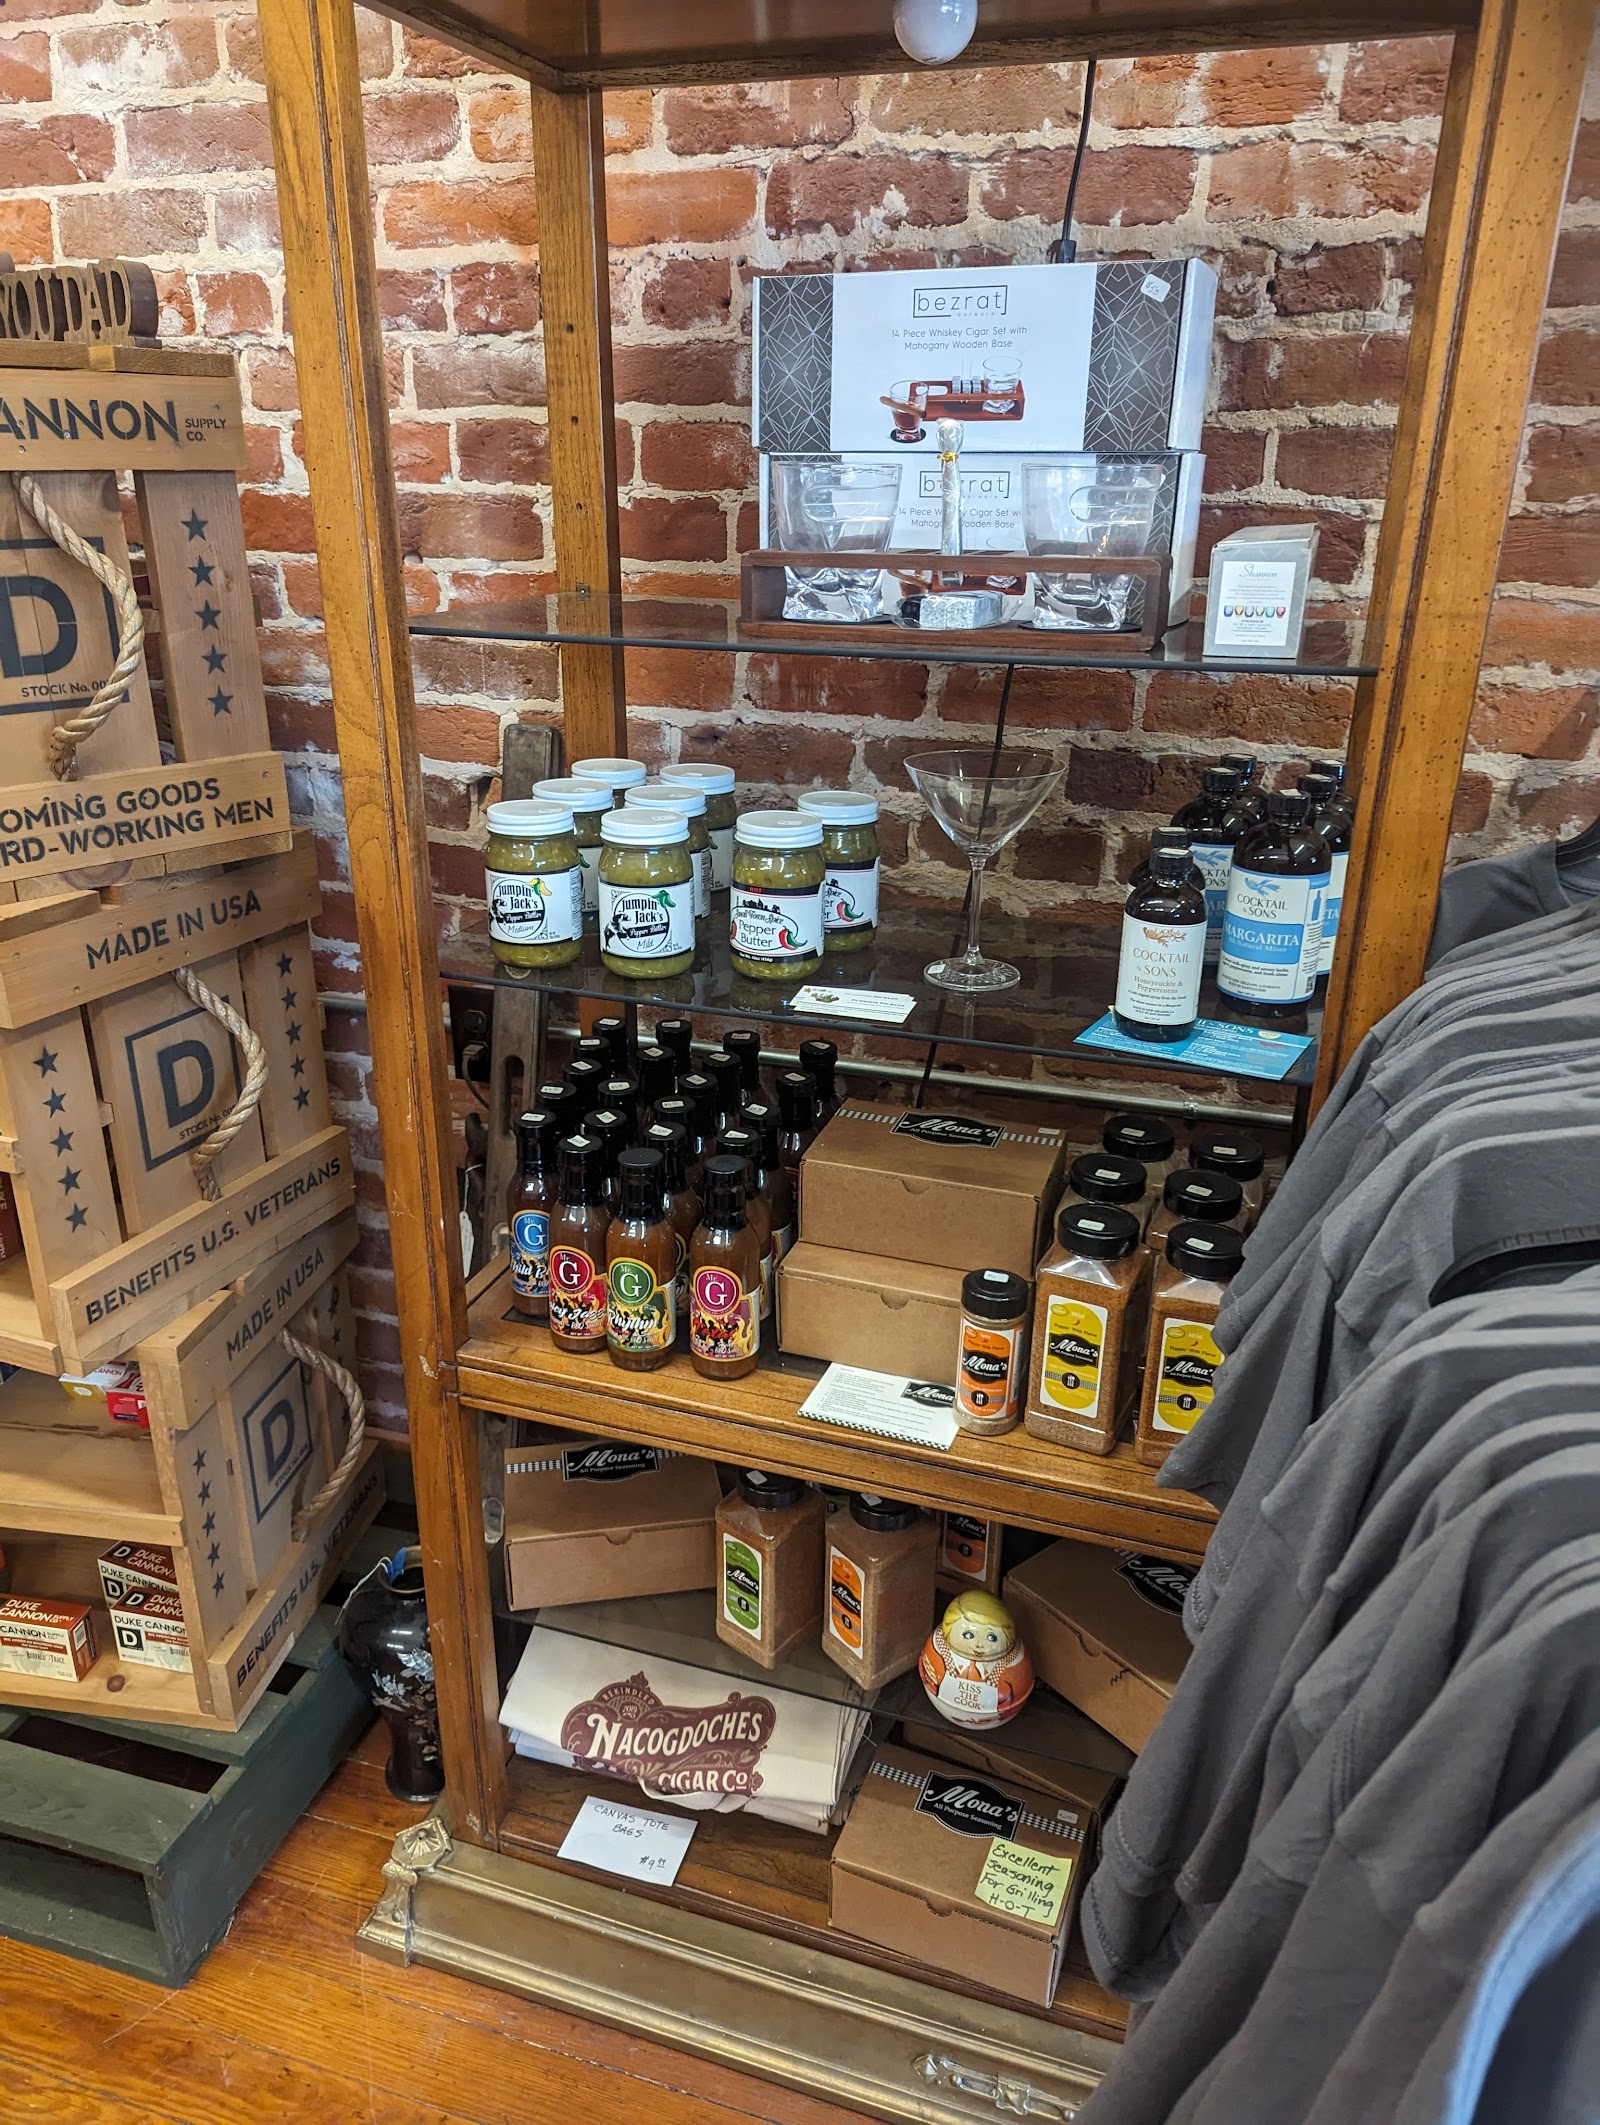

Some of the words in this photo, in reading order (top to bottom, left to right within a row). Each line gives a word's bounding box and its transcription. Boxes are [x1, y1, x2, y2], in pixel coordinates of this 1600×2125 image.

[55, 259, 132, 341] DAD
[917, 291, 1002, 312] bezrat
[891, 329, 900, 338] 14
[903, 329, 926, 338] Piece
[929, 328, 962, 341] Whiskey
[965, 327, 989, 338] Cigar
[992, 326, 1006, 336] Set
[1009, 326, 1027, 335] with
[904, 341, 949, 352] Mahogany
[952, 340, 988, 349] Wooden
[991, 339, 1013, 348] Base
[0, 397, 179, 441] ANNON
[184, 417, 226, 431] SUPPLY
[186, 430, 206, 442] CO.
[910, 508, 932, 516] Piece
[970, 508, 993, 517] Cigar
[996, 508, 1009, 516] Set
[995, 520, 1015, 528] Base
[2, 575, 78, 678] D
[21, 683, 67, 698] STOCK
[70, 682, 89, 694] No.
[0, 794, 107, 833] OMING
[116, 777, 221, 815] GOODS
[0, 808, 205, 868] RD-WORKING
[214, 796, 274, 829] MEN
[1205, 877, 1226, 887] ONS
[496, 885, 534, 898] Jumpin'
[510, 896, 538, 911] Jack's
[618, 897, 660, 913] Jumpin'
[1237, 893, 1288, 911] COCKTAIL
[634, 910, 664, 925] Jack's
[1248, 907, 1277, 920] SONS
[85, 917, 169, 971] MADE
[176, 906, 205, 940] IN
[210, 889, 262, 928] USA
[507, 924, 534, 934] Medium
[739, 919, 777, 936] Pepper
[1225, 921, 1300, 946] MARGARITA
[637, 938, 655, 951] Mild
[740, 933, 773, 948] Butter
[1133, 947, 1191, 963] COCKTAIL
[1143, 964, 1177, 978] SONS
[1134, 975, 1176, 987] Honeysuckle
[1137, 983, 1178, 994] Peppercorns
[1219, 1020, 1254, 1036] SONS
[156, 1039, 214, 1129] D
[179, 1119, 210, 1140] STOCK
[899, 1118, 998, 1138] Mona's
[921, 1129, 948, 1137] Purpose
[948, 1133, 982, 1142] Seasoning
[523, 1217, 536, 1225] Mr.
[85, 1244, 197, 1326] BENEFITS
[201, 1220, 240, 1253] U.S.
[243, 1156, 341, 1228] VETERANS
[523, 1223, 546, 1246] G
[559, 1253, 571, 1262] Mr.
[559, 1260, 581, 1286] G
[620, 1265, 632, 1274] Mr.
[705, 1273, 718, 1282] Mr.
[619, 1273, 642, 1298] G
[704, 1281, 728, 1306] G
[226, 1298, 274, 1362] MADE
[276, 1278, 292, 1308] IN
[294, 1248, 325, 1288] USA
[608, 1309, 658, 1331] Rhythm
[1071, 1311, 1085, 1319] Mild
[1049, 1339, 1099, 1357] Mona's
[962, 1355, 1008, 1371] Mona's
[906, 1385, 954, 1401] Mona
[261, 1399, 295, 1484] D
[567, 1449, 655, 1472] Mona's
[949, 1516, 986, 1534] Mona's
[113, 1545, 132, 1558] D
[135, 1549, 166, 1564] DUKE
[127, 1557, 173, 1577] CANNON
[101, 1565, 125, 1580] DUKE
[125, 1573, 164, 1591] CANNON
[236, 1589, 298, 1689] BENEFITS
[299, 1558, 321, 1595] U.S.
[323, 1471, 378, 1554] VETERANS
[727, 1569, 760, 1591] Mona's
[107, 1580, 121, 1597] D
[6, 1599, 42, 1611] DUKE
[125, 1593, 145, 1606] D
[150, 1594, 182, 1606] DUKE
[832, 1585, 861, 1611] Mona's
[0, 1607, 53, 1622] CANNON
[143, 1603, 183, 1617] CANNO
[114, 1615, 143, 1628] DUKE
[0, 1625, 47, 1639] CANNON
[121, 1629, 138, 1646] D
[602, 1686, 655, 1705] REKINDLED
[958, 1681, 982, 1695] KISS
[959, 1690, 979, 1702] THE
[622, 1705, 638, 1713] 2019
[953, 1697, 981, 1710] COOK
[585, 1711, 763, 1761] NACOGDOCHES
[658, 1769, 720, 1793] CIGAR
[922, 1785, 1020, 1823] Mona's
[594, 1804, 636, 1823] CANVAS
[643, 1817, 670, 1831] TOTE
[933, 1802, 945, 1812] All
[944, 1806, 970, 1820] Purpose
[970, 1813, 1004, 1831] Seasoning
[612, 1823, 644, 1838] BAGS
[992, 1843, 1061, 1876] Excellent
[979, 1872, 1004, 1889] For
[1005, 1884, 1054, 1918] Grilling
[989, 1892, 1036, 1918] H-O-T
